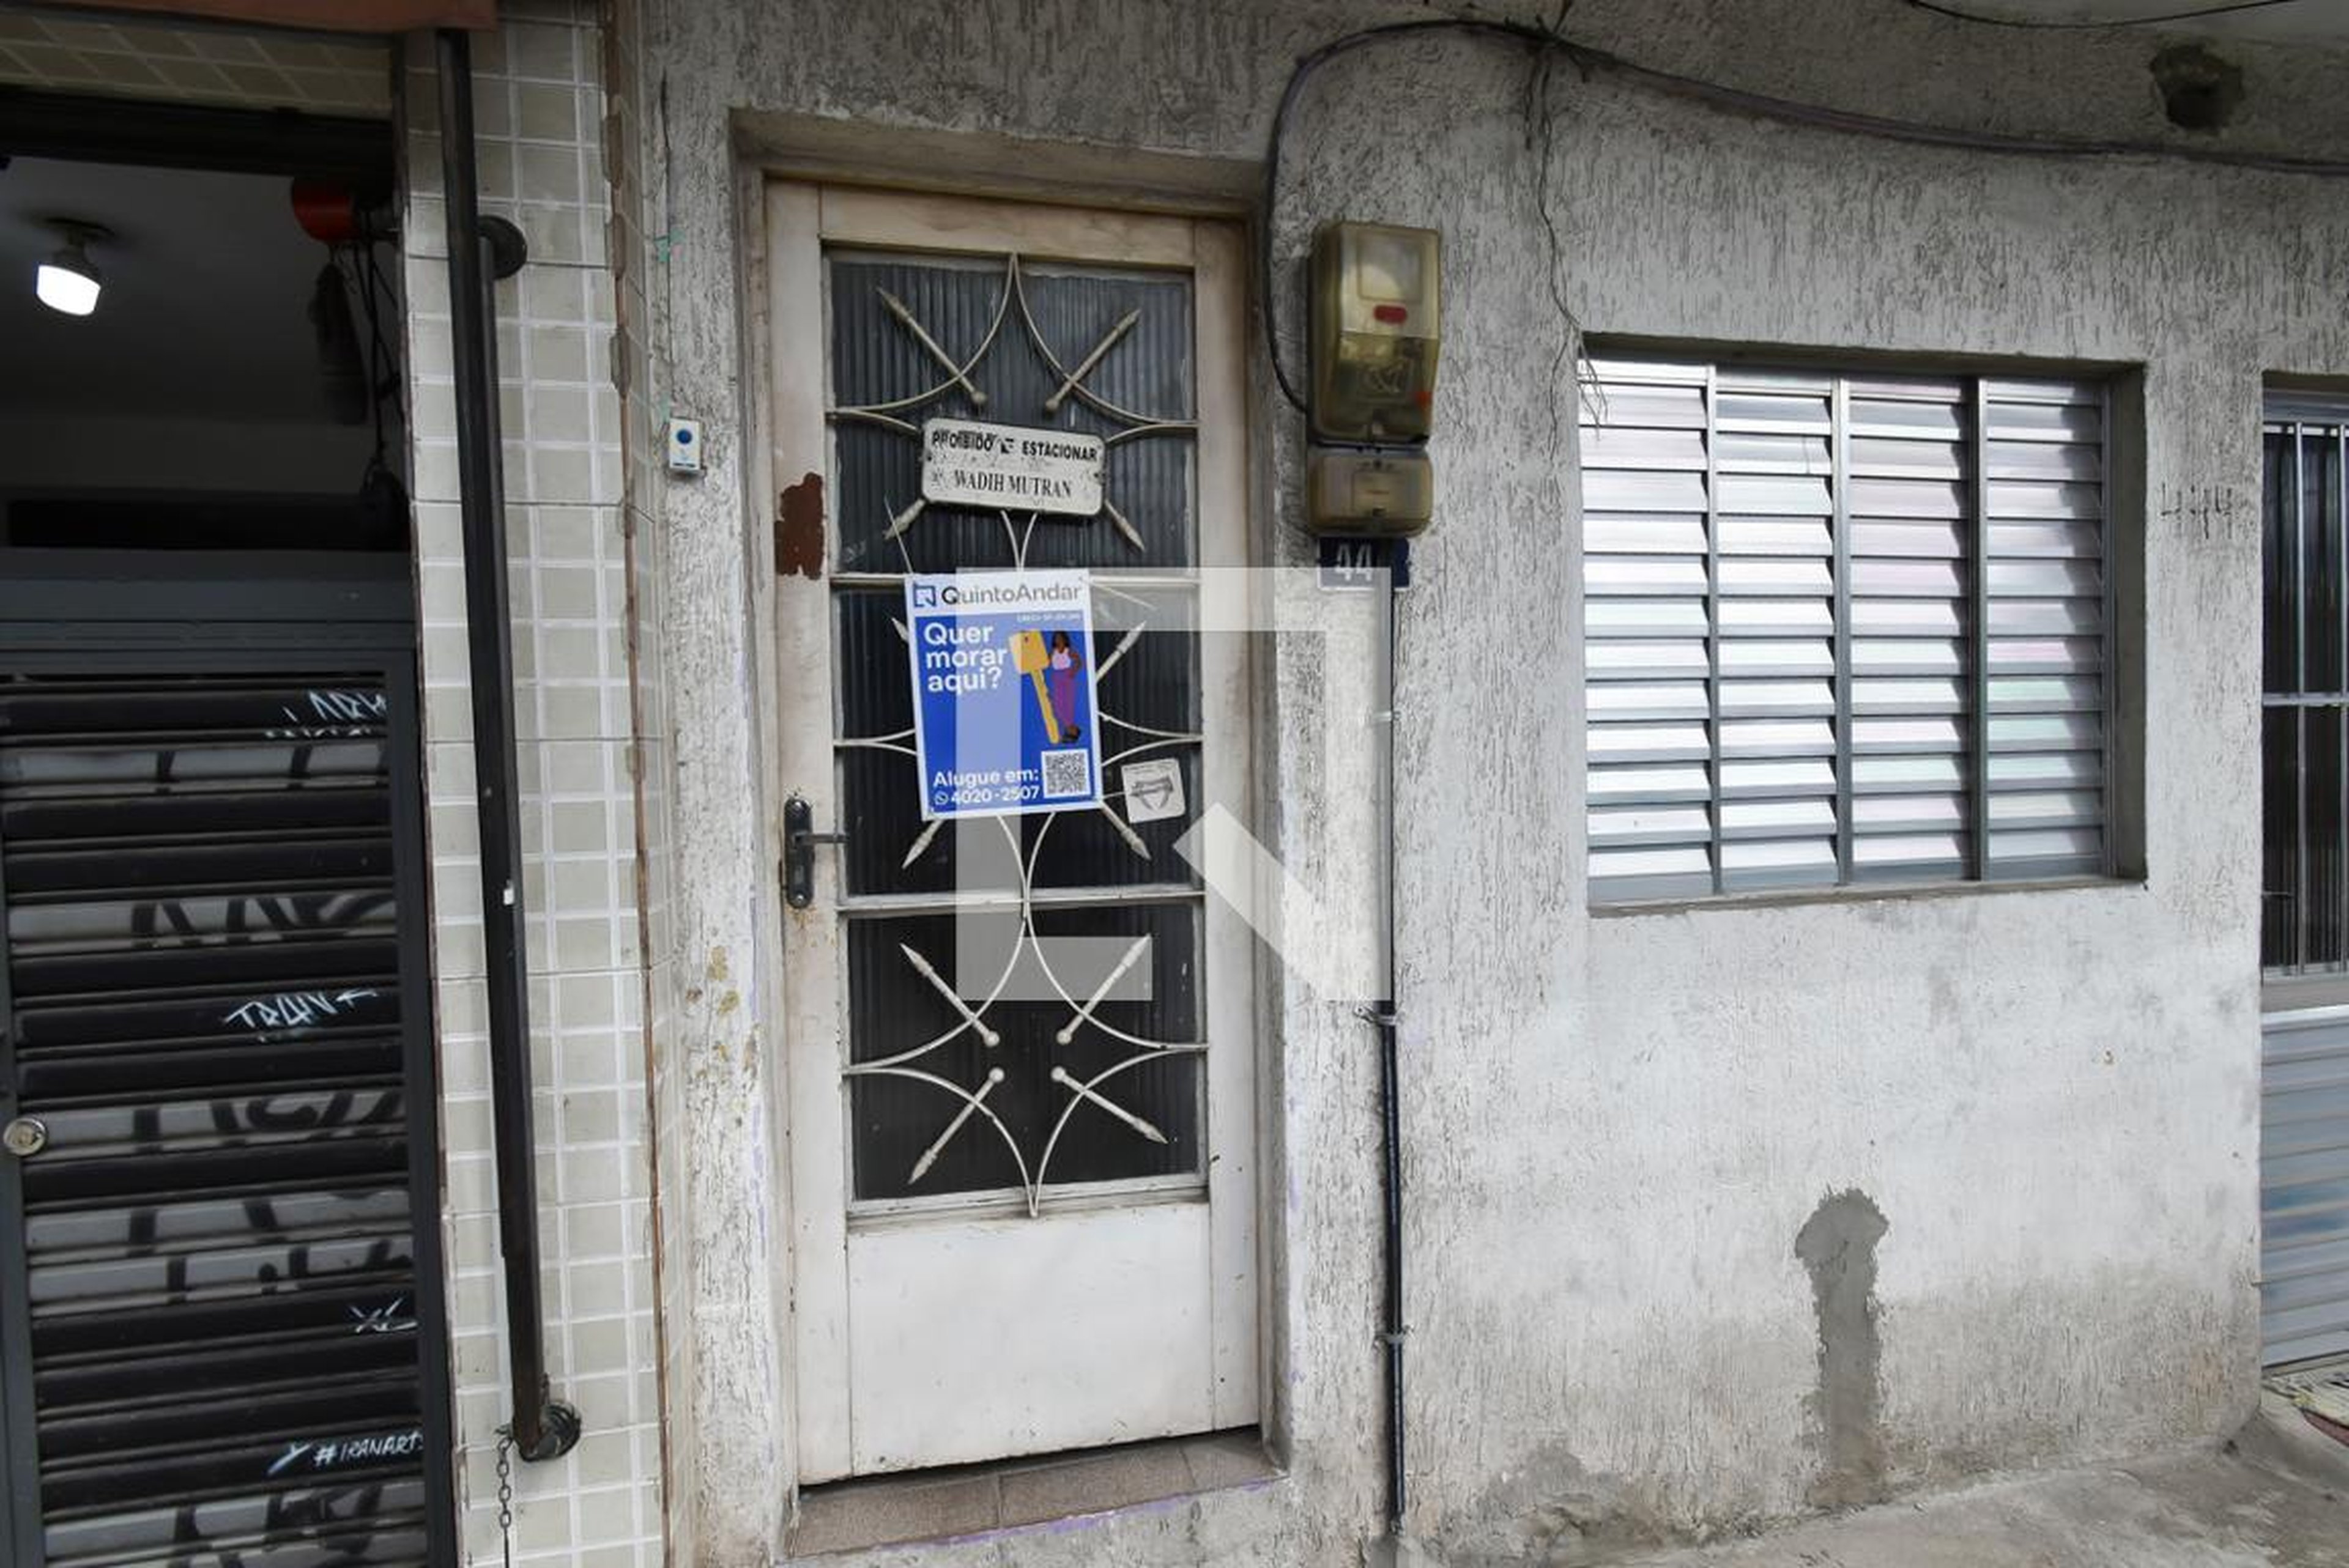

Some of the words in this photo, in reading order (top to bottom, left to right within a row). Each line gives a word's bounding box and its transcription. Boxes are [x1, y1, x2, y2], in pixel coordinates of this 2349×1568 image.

[1022, 440, 1097, 462] ESTACIONAR
[954, 468, 1004, 492] WADIH
[941, 582, 1082, 606] QuintoAndar
[923, 621, 994, 646] Quer
[925, 648, 1008, 669] morar
[927, 666, 1003, 695] aqui?
[933, 769, 1001, 790] Alugue
[1004, 768, 1039, 783] em:
